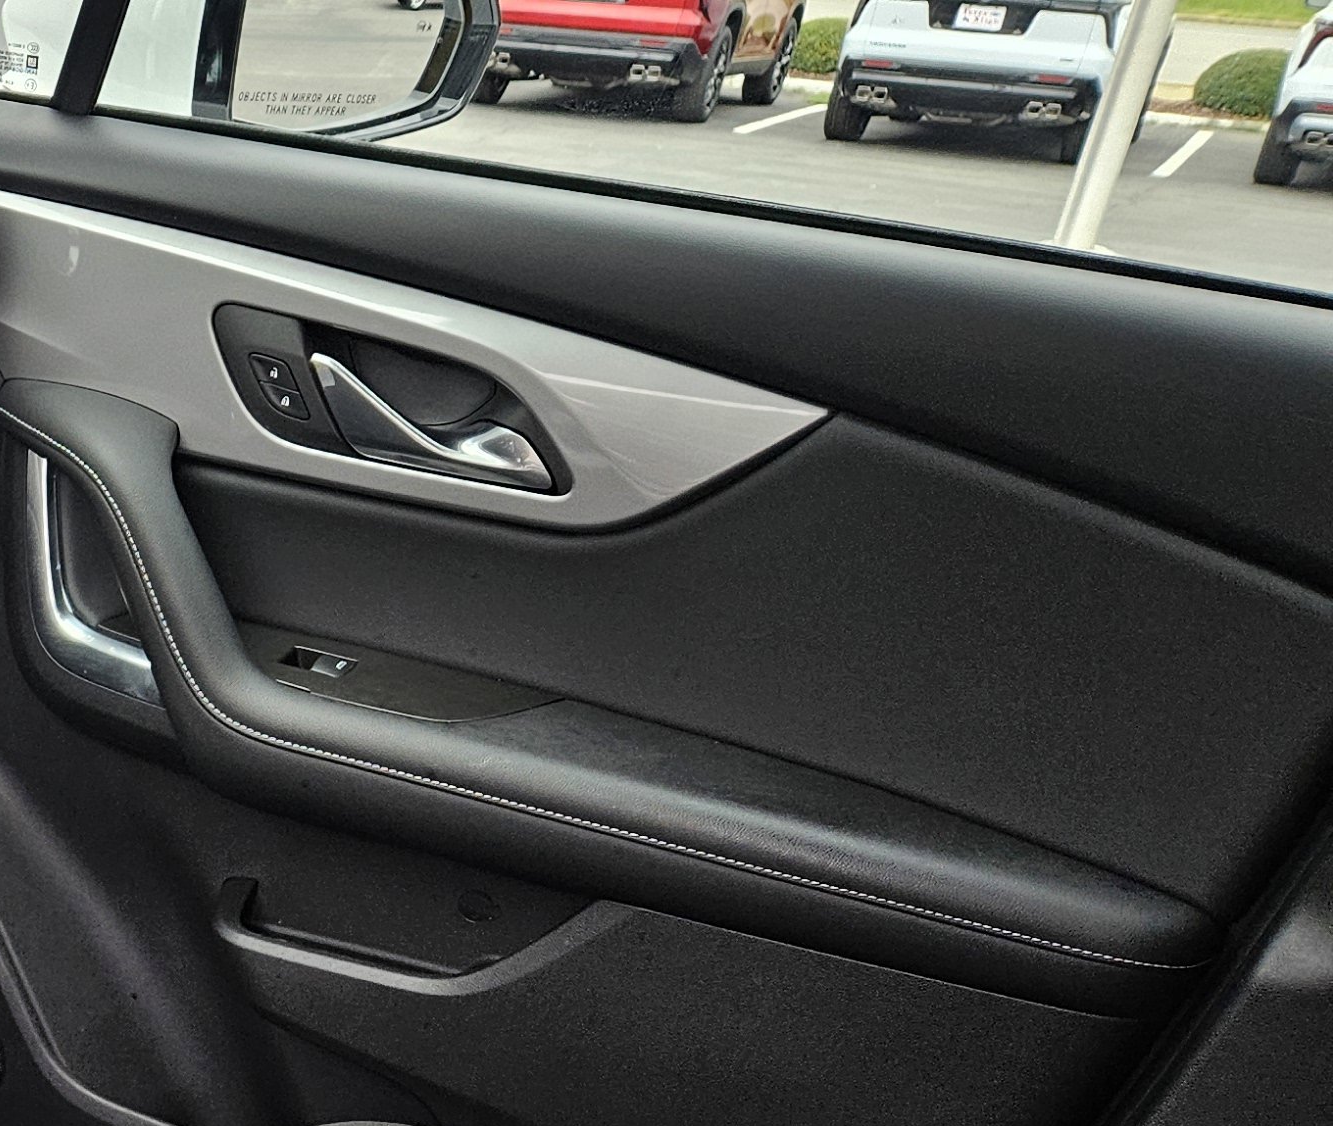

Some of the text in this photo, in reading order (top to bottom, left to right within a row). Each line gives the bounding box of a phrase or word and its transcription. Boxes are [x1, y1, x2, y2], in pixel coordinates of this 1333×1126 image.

[238, 91, 377, 105] OBJECTS IN MIRROR ARE CLOSER
[265, 104, 347, 116] THAN THEY APPEAR
